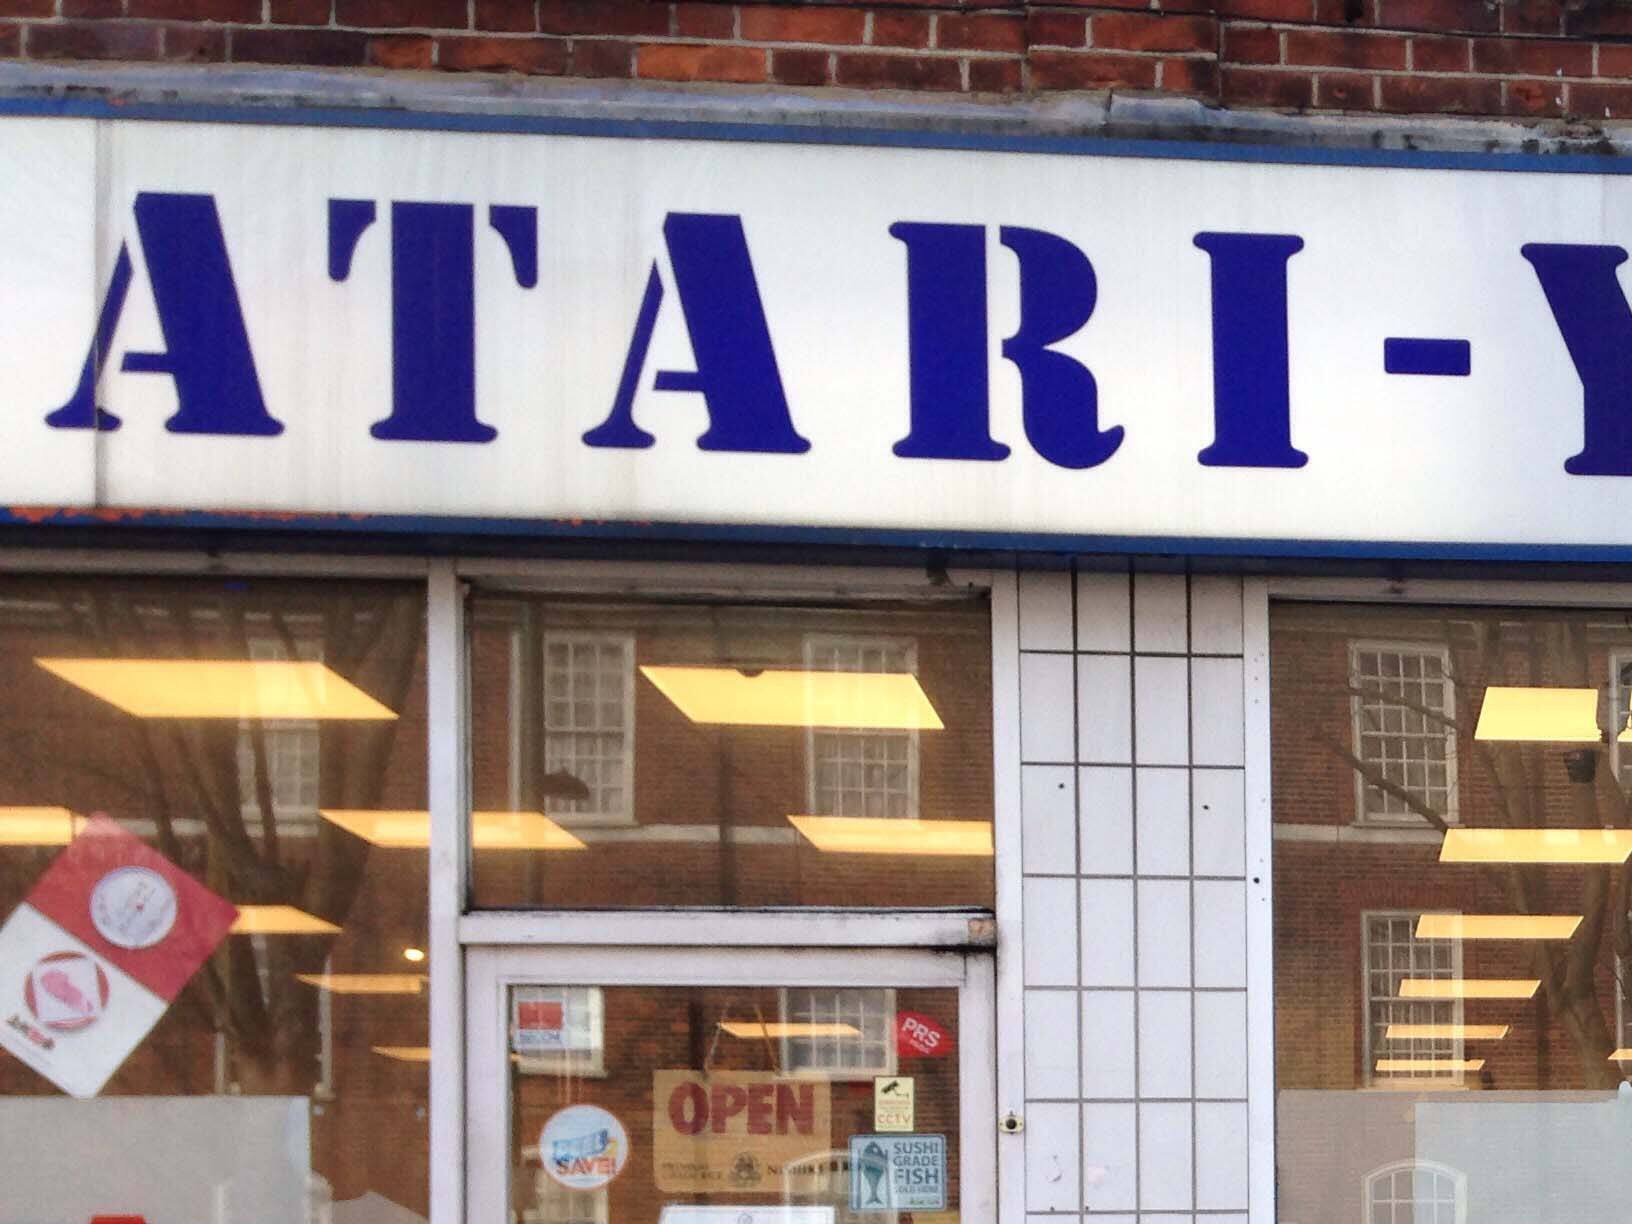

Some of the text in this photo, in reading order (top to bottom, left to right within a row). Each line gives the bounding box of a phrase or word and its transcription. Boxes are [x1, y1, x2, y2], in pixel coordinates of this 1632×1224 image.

[902, 1017, 940, 1048] PRS
[668, 1081, 815, 1136] OPEN
[878, 1113, 911, 1124] CCTV
[893, 1142, 939, 1154] SUSHI
[892, 1155, 938, 1167] GRADE
[895, 1167, 938, 1185] FISH
